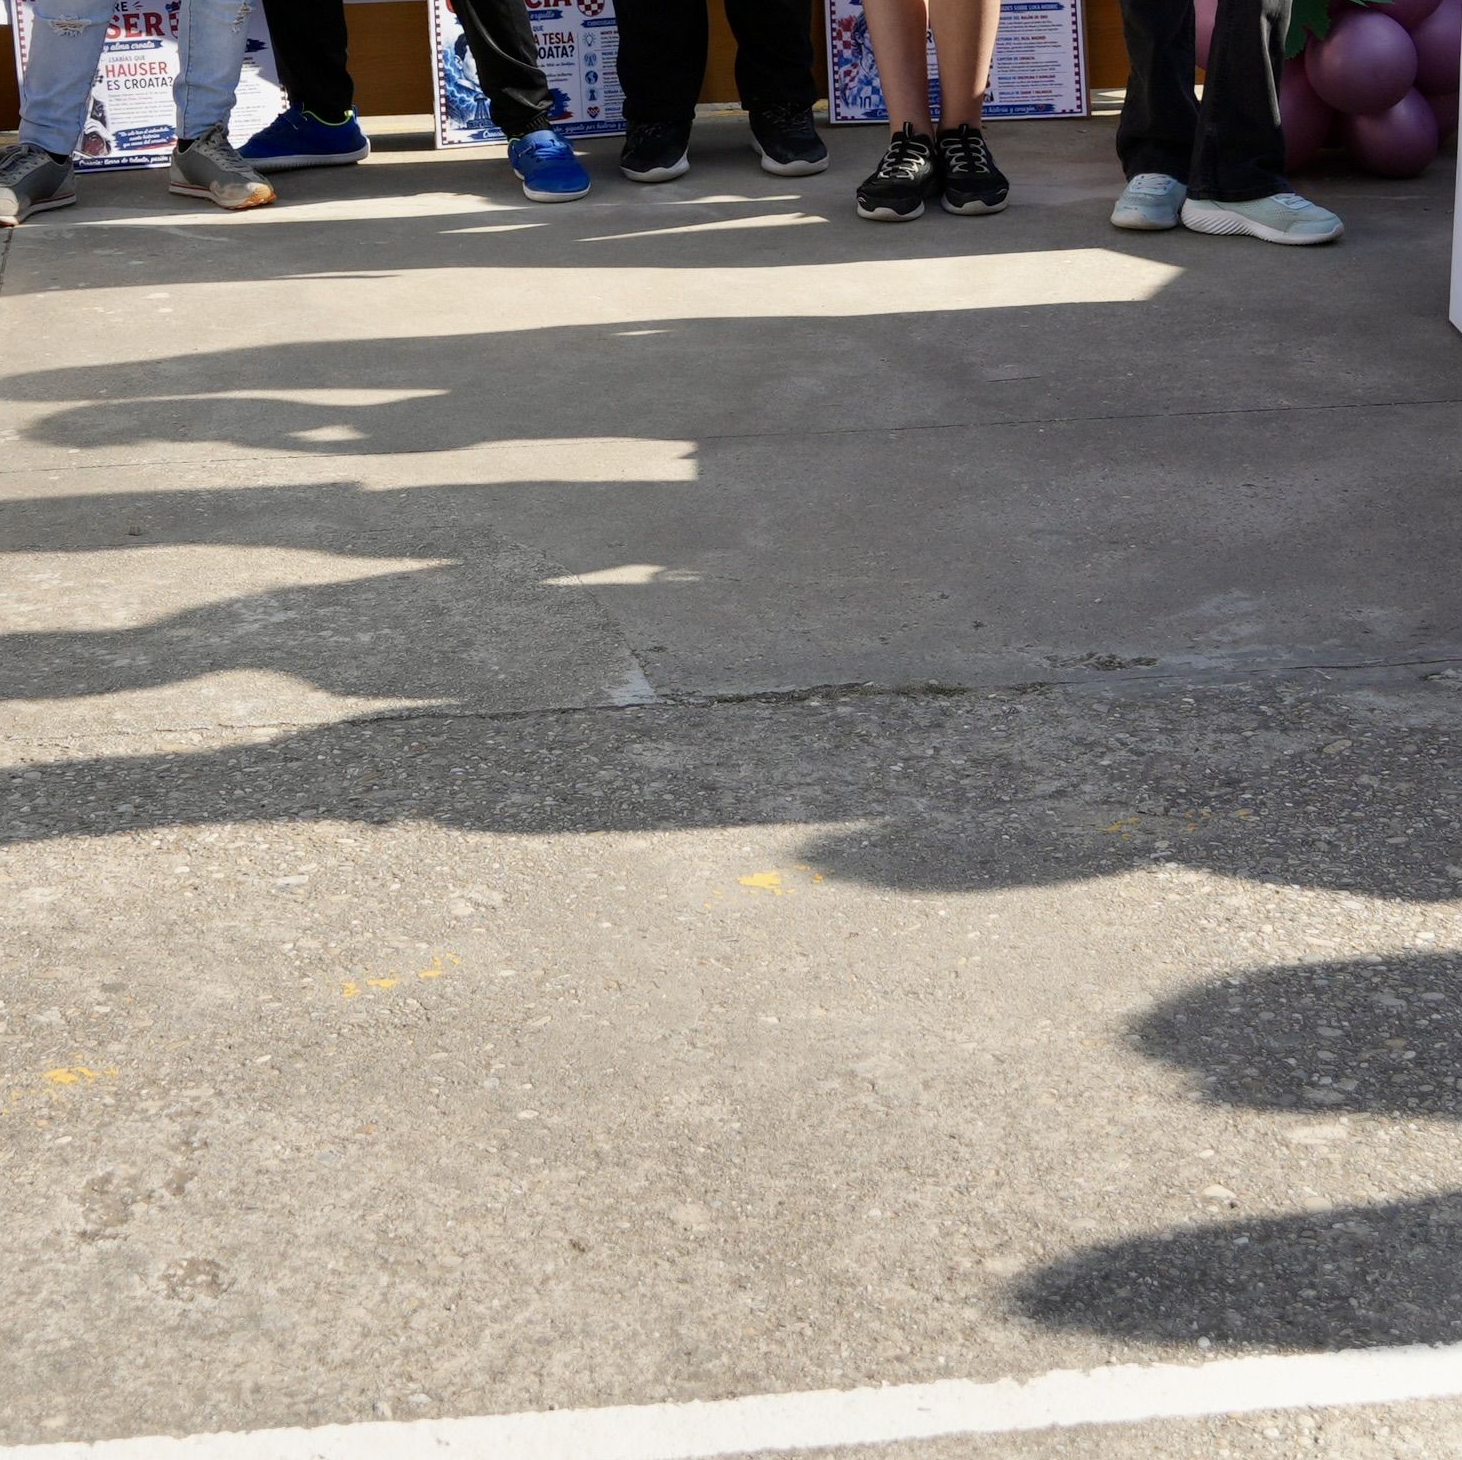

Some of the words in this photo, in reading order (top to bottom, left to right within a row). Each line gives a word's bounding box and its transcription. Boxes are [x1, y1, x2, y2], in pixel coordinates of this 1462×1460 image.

[106, 12, 165, 39] SER
[544, 32, 574, 44] TESLA
[539, 45, 575, 59] OATA?
[105, 62, 168, 78] HAUSER
[107, 80, 120, 91] ES
[124, 77, 173, 90] CROATA?
